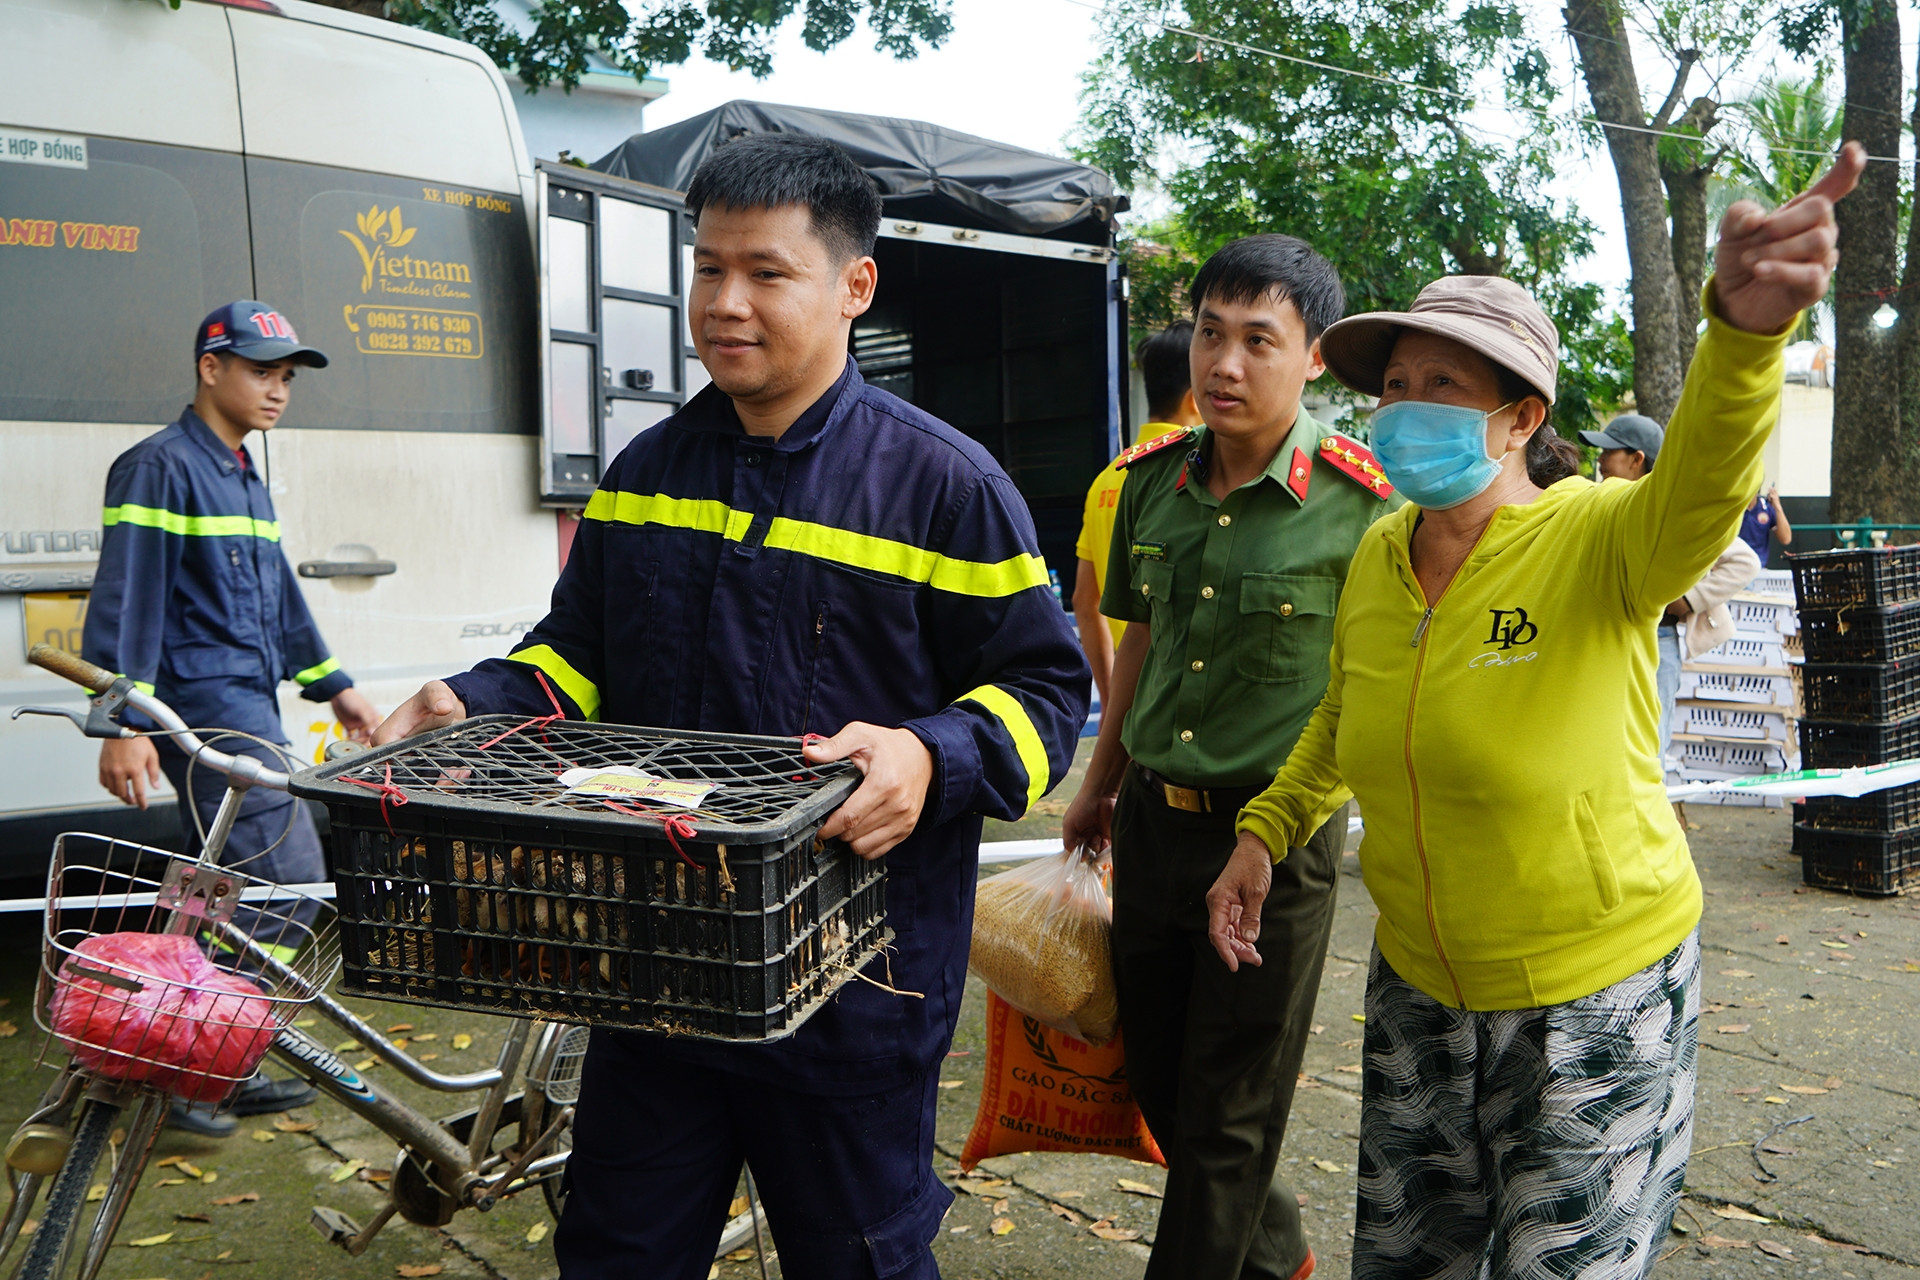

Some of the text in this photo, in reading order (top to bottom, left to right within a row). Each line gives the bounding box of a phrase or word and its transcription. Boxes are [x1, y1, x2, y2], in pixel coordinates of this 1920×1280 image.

[423, 187, 441, 202] XE
[61, 221, 140, 252] VINH
[337, 230, 472, 294] Vietnam
[379, 279, 472, 299] Timeless Charm
[367, 312, 471, 334] 0905 746 930
[369, 332, 472, 354] 0828 392 679
[1012, 1067, 1055, 1089] GẠO
